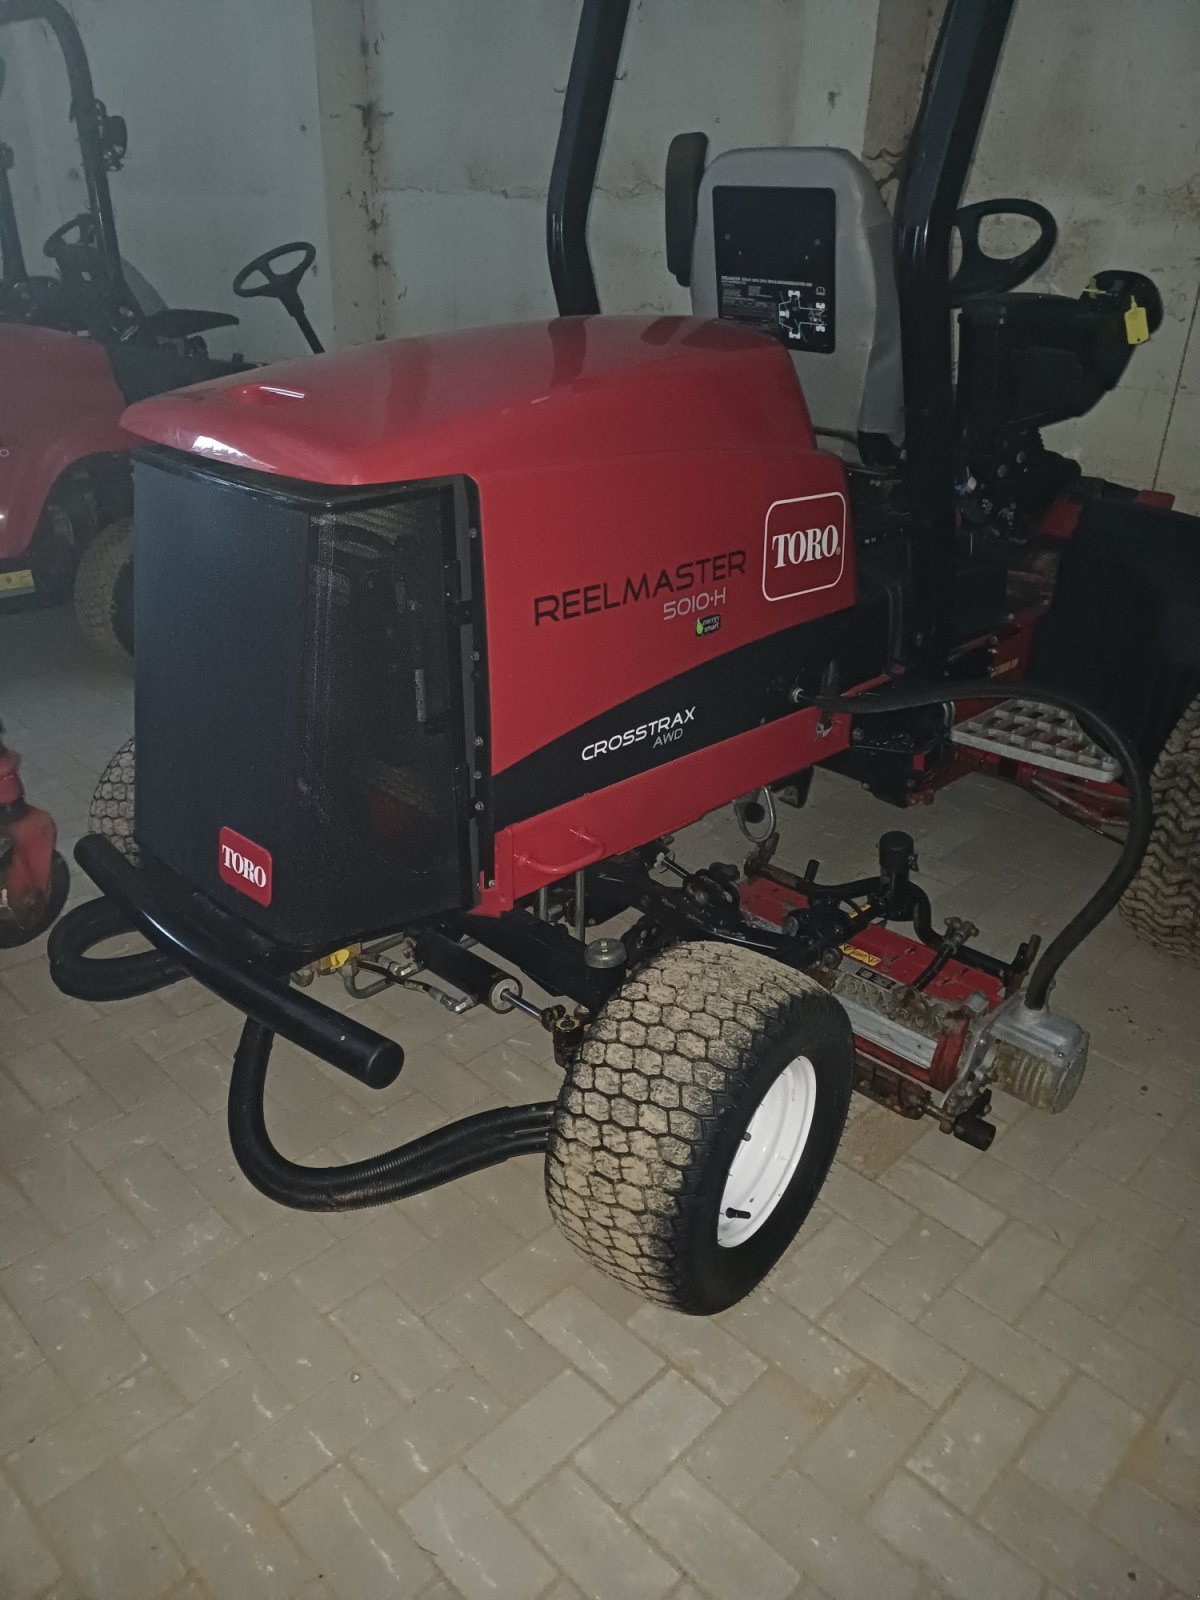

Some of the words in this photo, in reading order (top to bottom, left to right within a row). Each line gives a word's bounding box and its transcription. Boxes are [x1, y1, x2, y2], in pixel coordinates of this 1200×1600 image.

[534, 550, 746, 626] REELMASTER
[581, 706, 696, 761] CROSSTRAX
[652, 728, 684, 749] AWD
[222, 844, 267, 888] TORO
